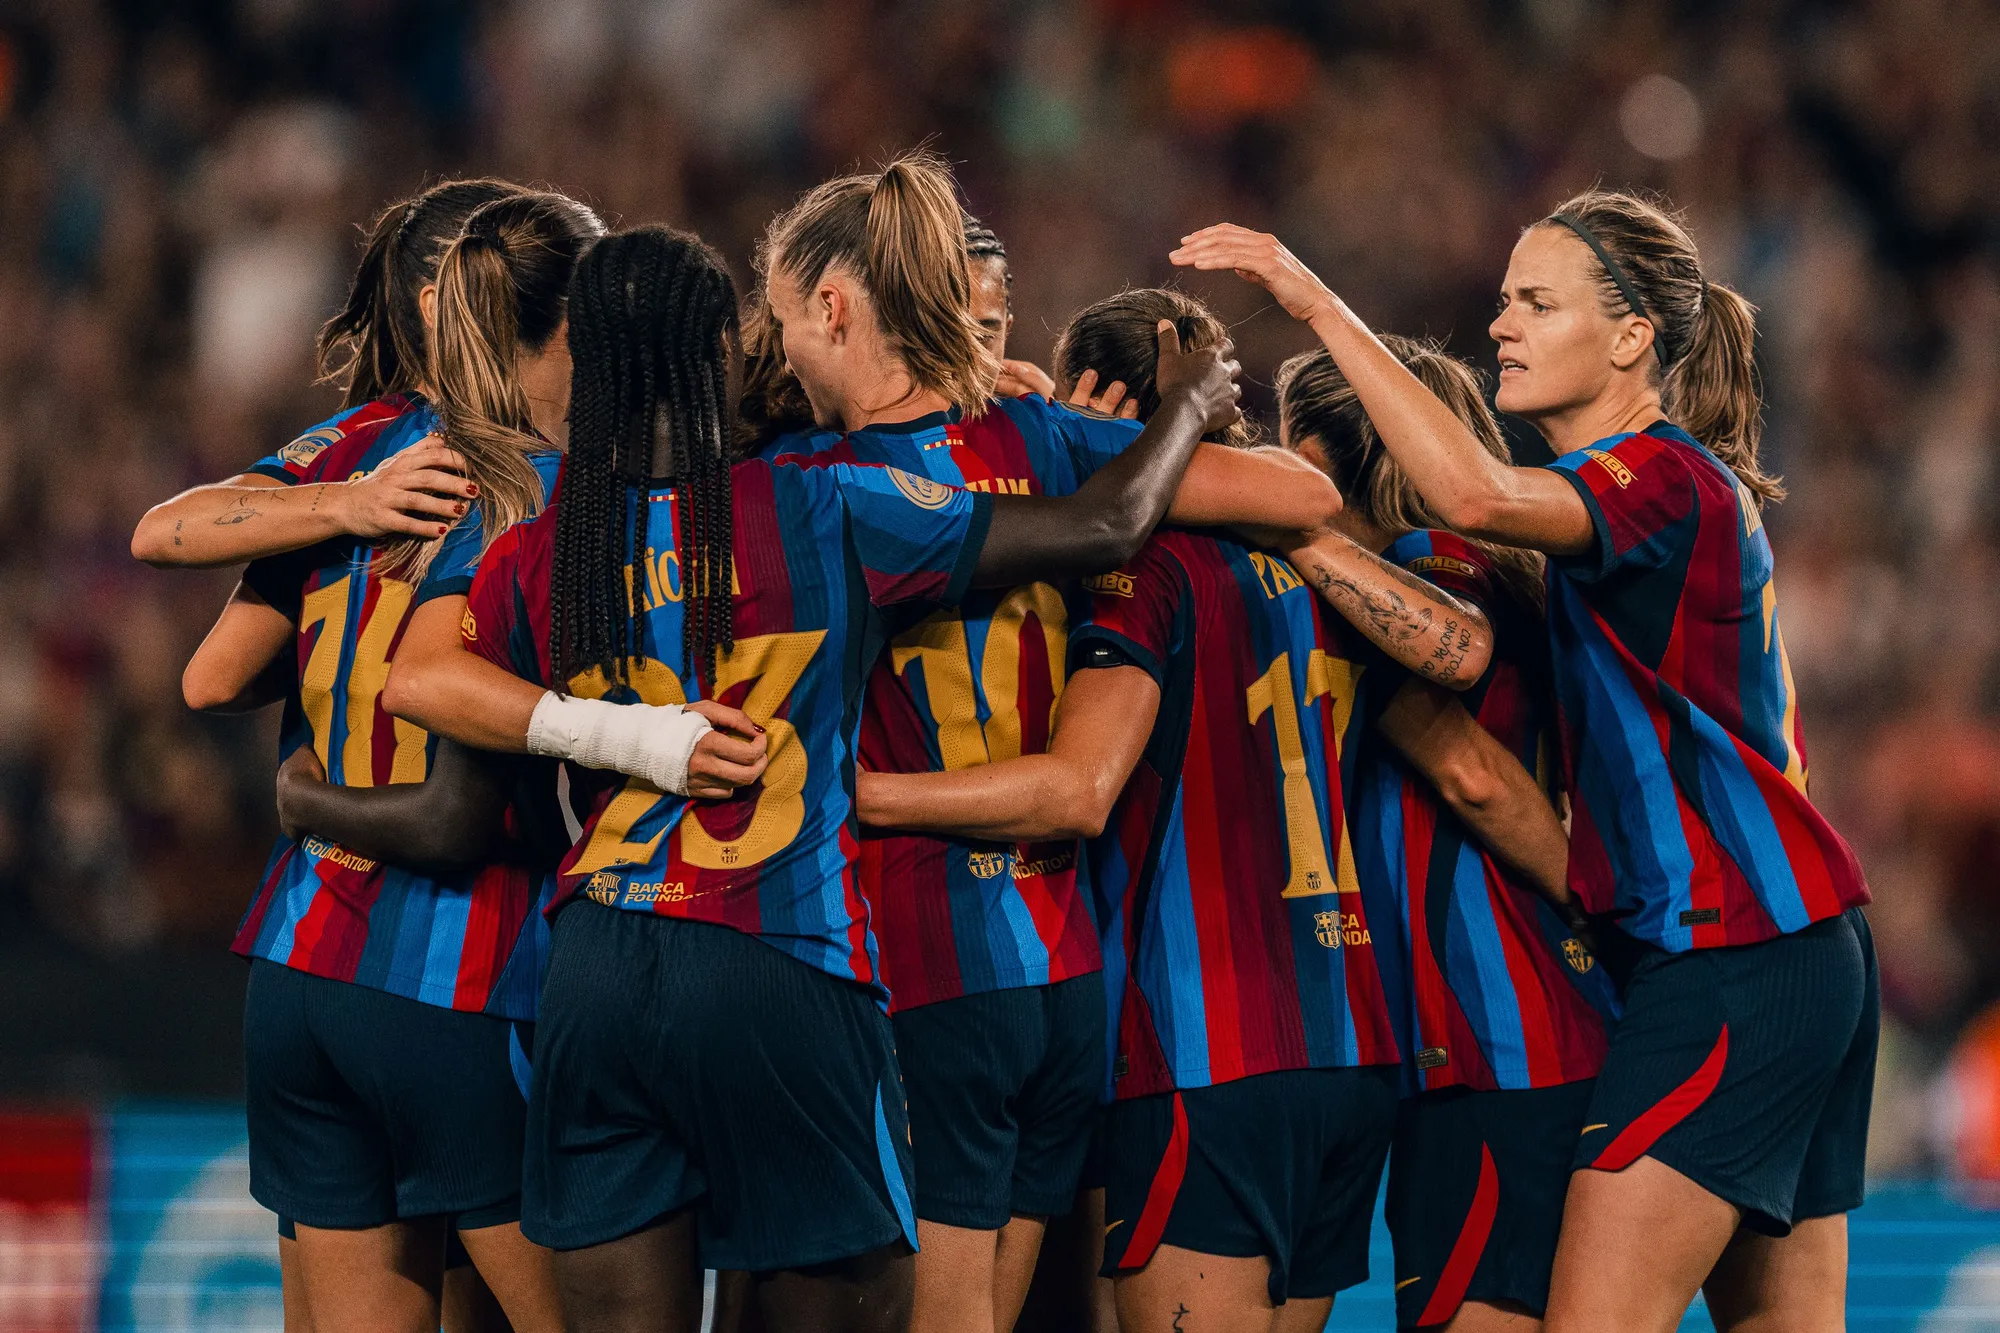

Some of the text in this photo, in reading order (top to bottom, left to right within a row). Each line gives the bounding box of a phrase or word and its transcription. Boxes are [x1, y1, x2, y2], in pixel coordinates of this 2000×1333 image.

[891, 580, 1069, 772] 10
[1456, 628, 1471, 653] CON
[562, 629, 829, 876] 23
[1246, 648, 1367, 899] 17
[629, 882, 685, 895] BARÇA
